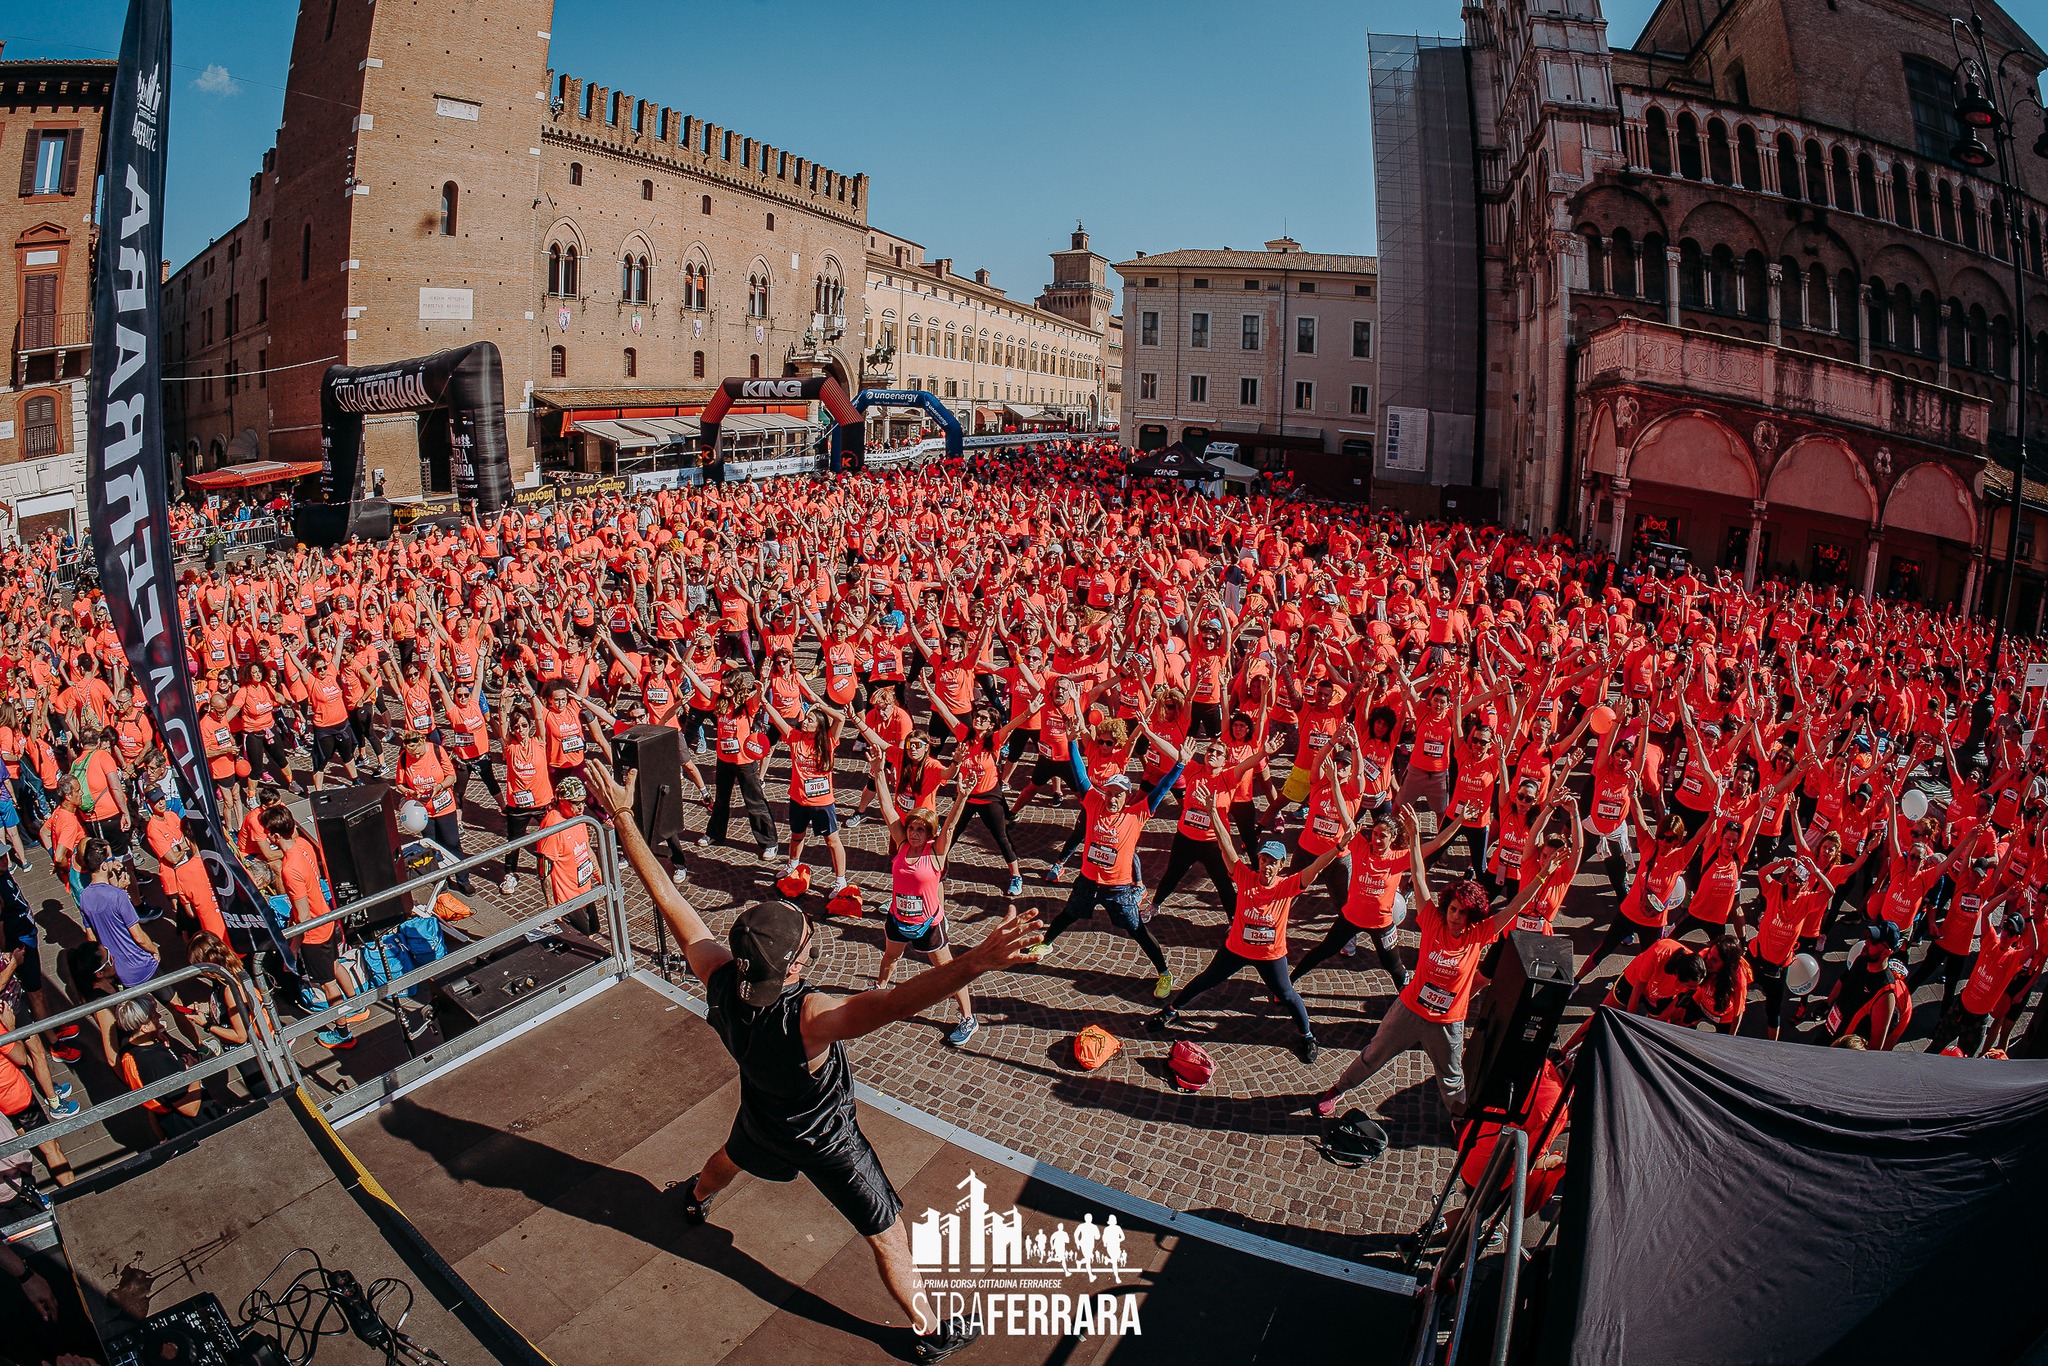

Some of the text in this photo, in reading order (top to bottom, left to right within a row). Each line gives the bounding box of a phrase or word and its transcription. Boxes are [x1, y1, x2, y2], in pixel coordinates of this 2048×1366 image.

[335, 372, 434, 412] STRAFERRARA
[743, 381, 801, 397] KING
[874, 391, 918, 402] unoenergy
[810, 782, 825, 790] 3769
[1190, 813, 1205, 824] 3281
[1318, 821, 1332, 831] 1502
[1094, 850, 1109, 861] 1345
[900, 900, 915, 909] 3931
[1522, 919, 1537, 930] 3182
[1250, 931, 1267, 940] 1344
[1427, 991, 1446, 1005] 3316
